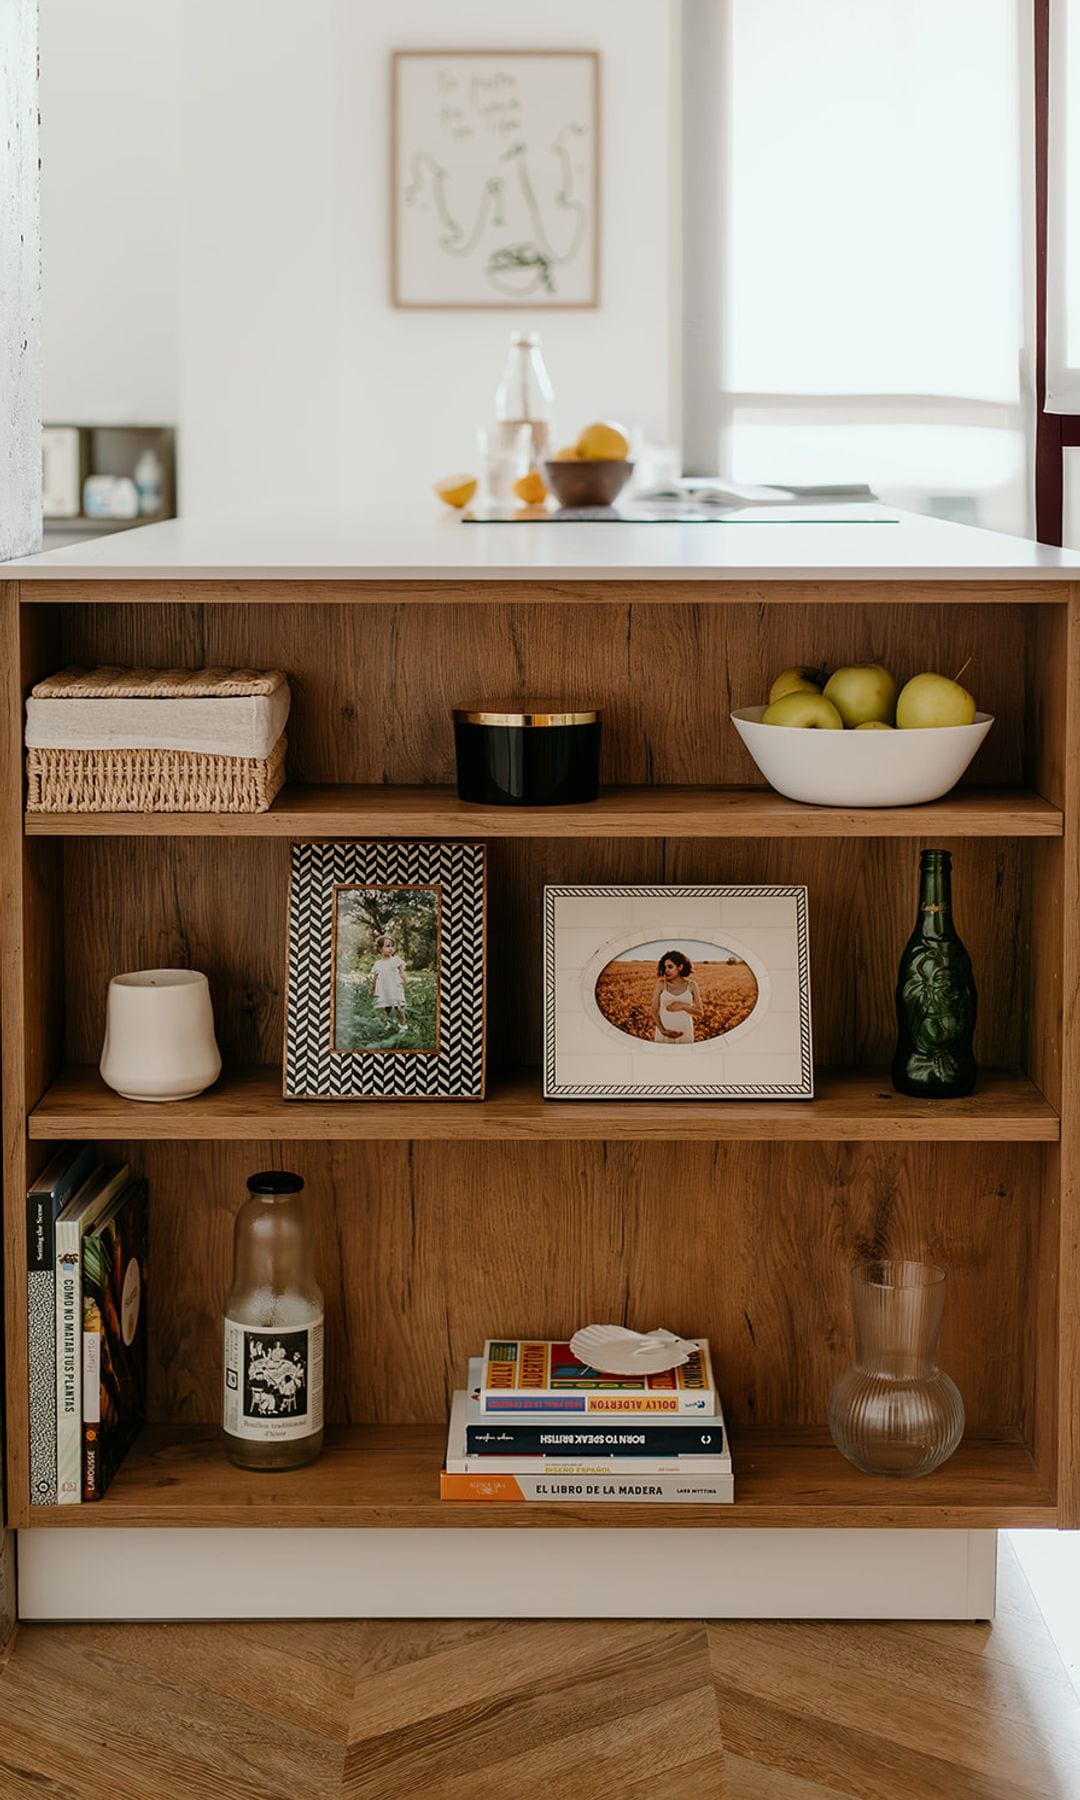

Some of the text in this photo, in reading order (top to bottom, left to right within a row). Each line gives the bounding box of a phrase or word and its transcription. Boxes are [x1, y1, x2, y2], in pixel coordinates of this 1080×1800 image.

[36, 1204, 44, 1261] Setting the Scene
[64, 1308, 74, 1321] NO
[64, 1323, 74, 1353] MATAR
[64, 1355, 74, 1372] TUS
[86, 1338, 95, 1373] Huerto
[522, 1345, 544, 1389] ALDERTON
[490, 1363, 512, 1389] DOLLY
[64, 1374, 75, 1413] PLANTAS
[589, 1399, 642, 1410] ALDERTON
[646, 1399, 677, 1410] DOLLY
[540, 1434, 646, 1444] BORN TO SPEAK BRITISH
[87, 1450, 95, 1491] LAROUSSE
[536, 1485, 663, 1495] EL LIBRO DE LA MADERA
